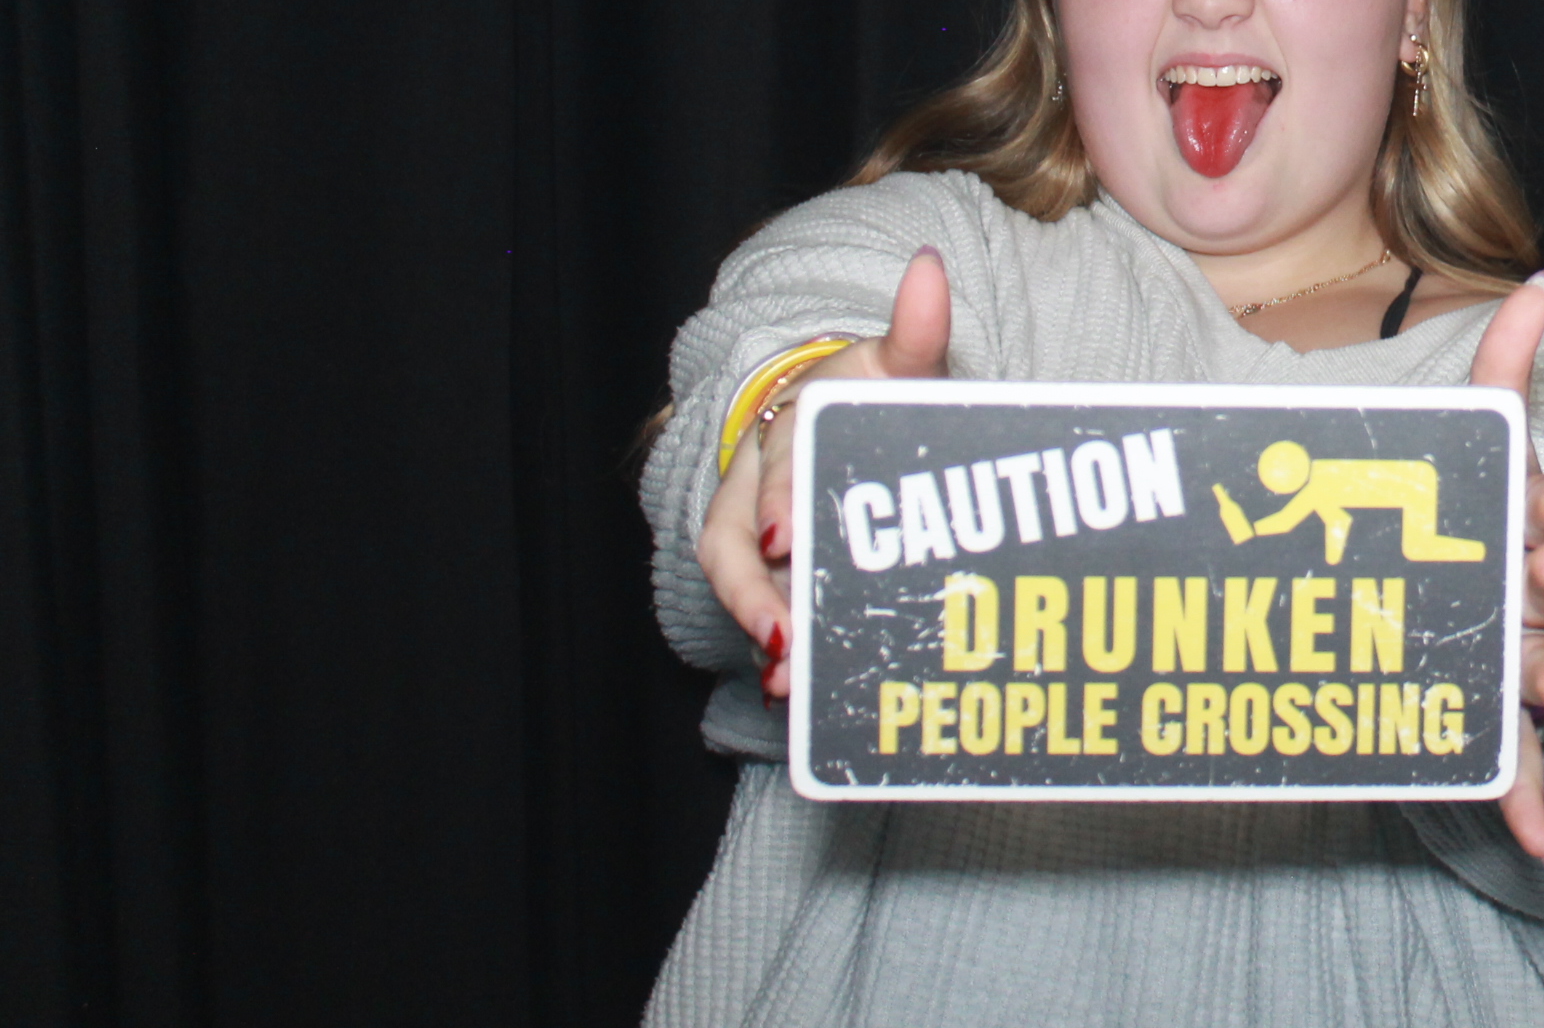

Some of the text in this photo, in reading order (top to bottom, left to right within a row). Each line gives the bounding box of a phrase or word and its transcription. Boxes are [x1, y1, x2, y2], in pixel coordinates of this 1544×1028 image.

[843, 428, 1186, 571] CAUTION
[943, 575, 1405, 672] DRUNKEN
[879, 682, 1465, 756] PEOPLE CROSSING
